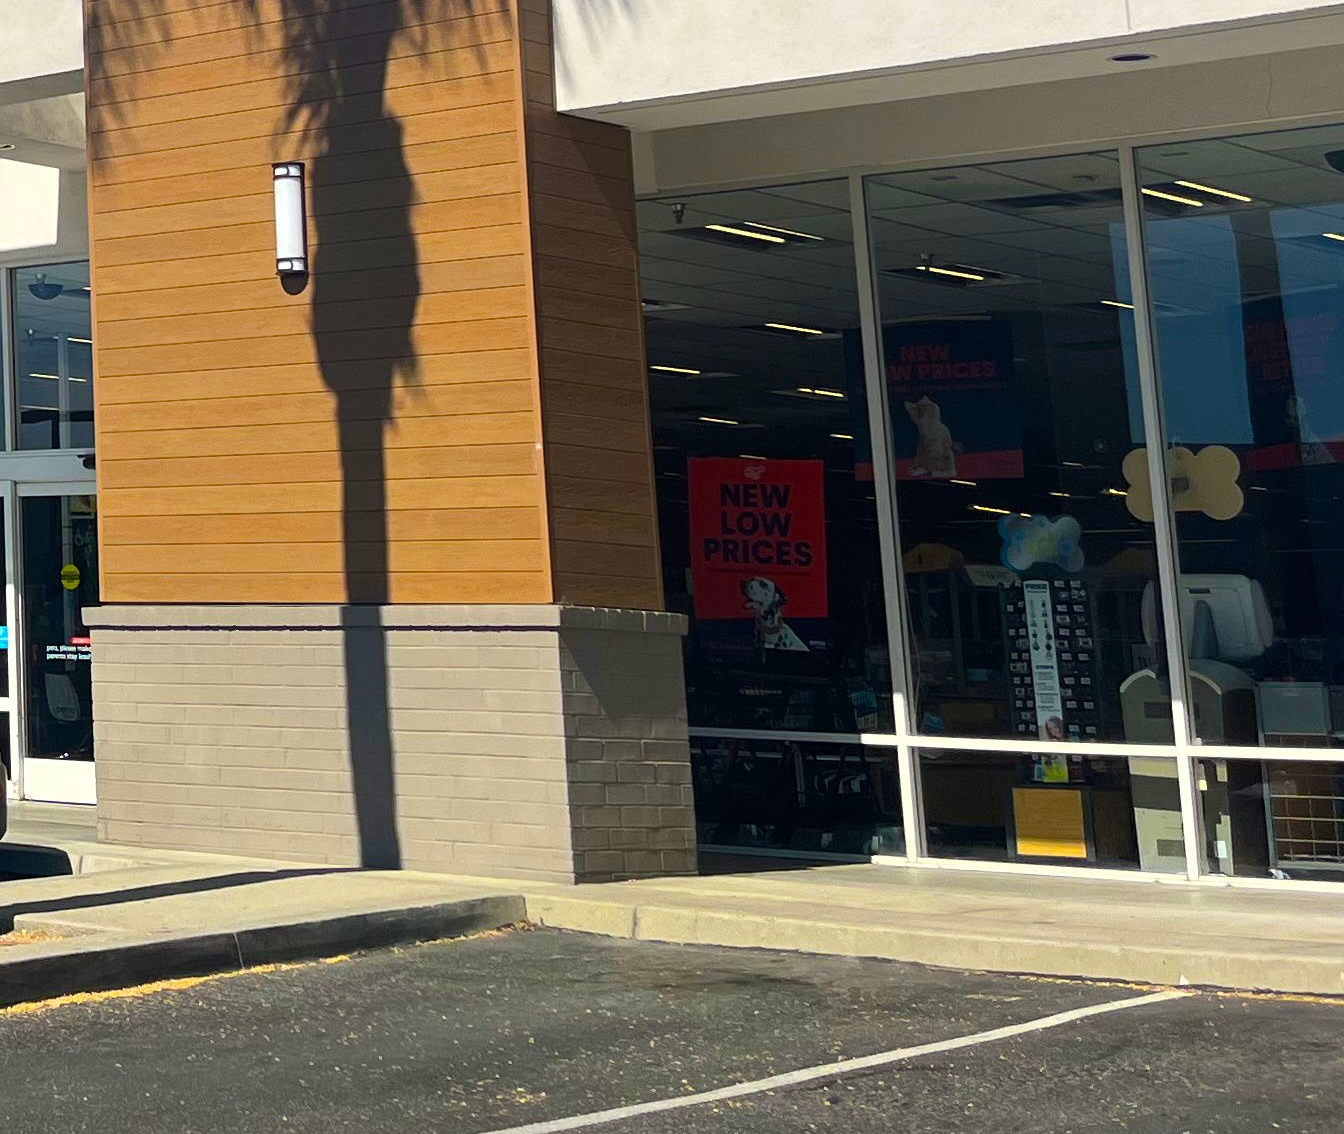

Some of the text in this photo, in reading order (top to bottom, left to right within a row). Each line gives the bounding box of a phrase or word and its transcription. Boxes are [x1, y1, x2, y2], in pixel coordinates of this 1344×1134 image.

[900, 344, 950, 362] NEW
[919, 361, 997, 380] PRICES
[720, 483, 792, 509] NEW
[720, 511, 792, 537] LOW
[703, 538, 813, 566] PRICES
